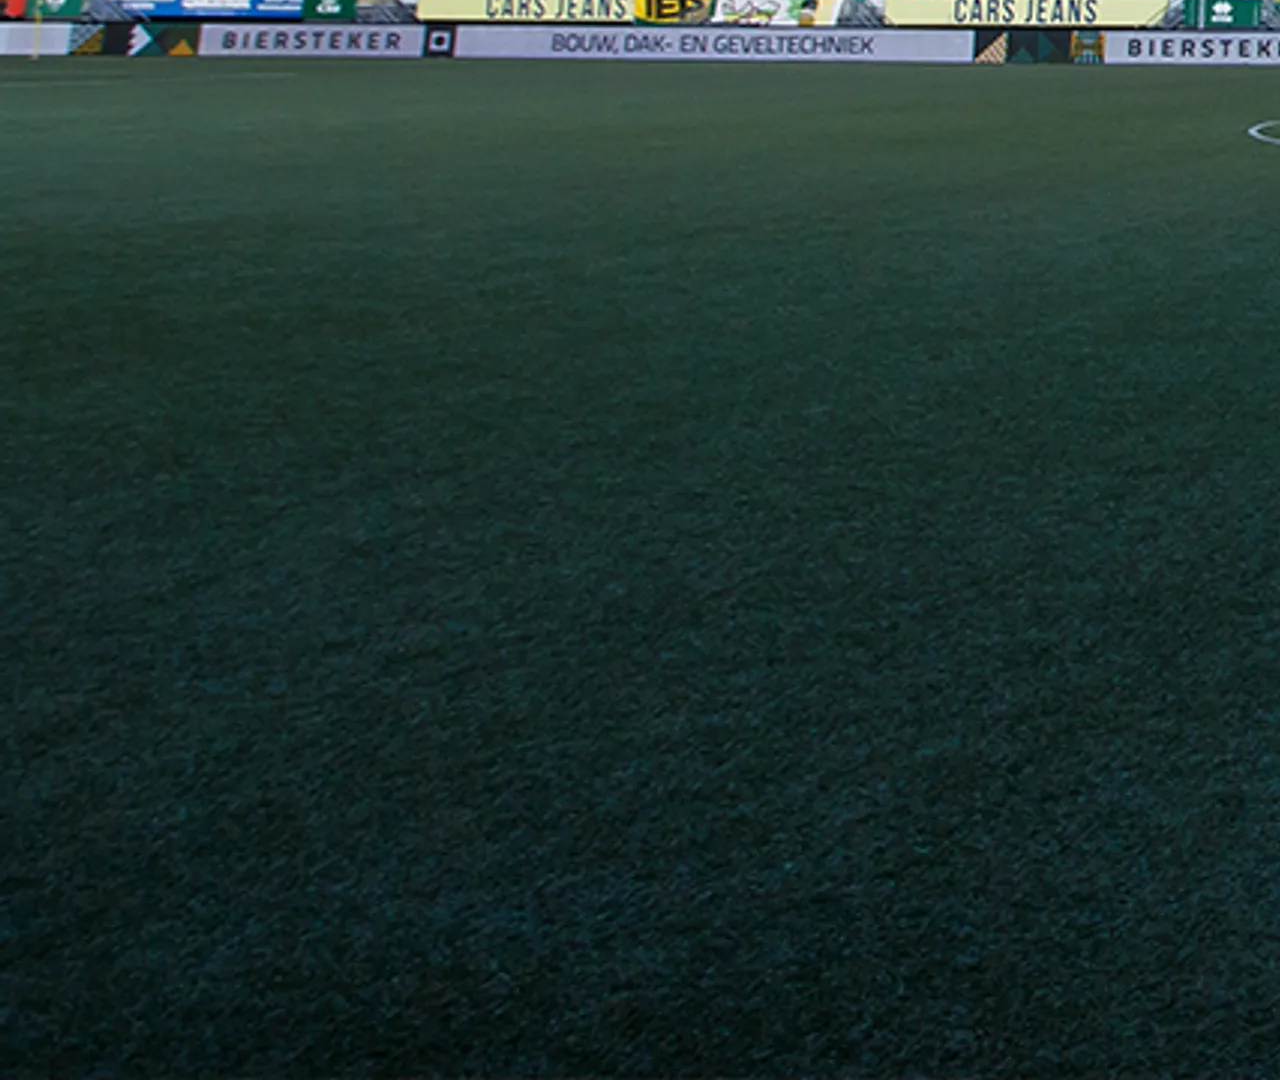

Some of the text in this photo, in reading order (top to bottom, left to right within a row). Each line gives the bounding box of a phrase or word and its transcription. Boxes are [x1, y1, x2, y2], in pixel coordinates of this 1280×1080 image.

[222, 30, 402, 51] BIERSTEKER
[552, 32, 619, 56] BOUW,
[680, 33, 707, 53] EN
[713, 33, 874, 55] GEVELTECHNIEK
